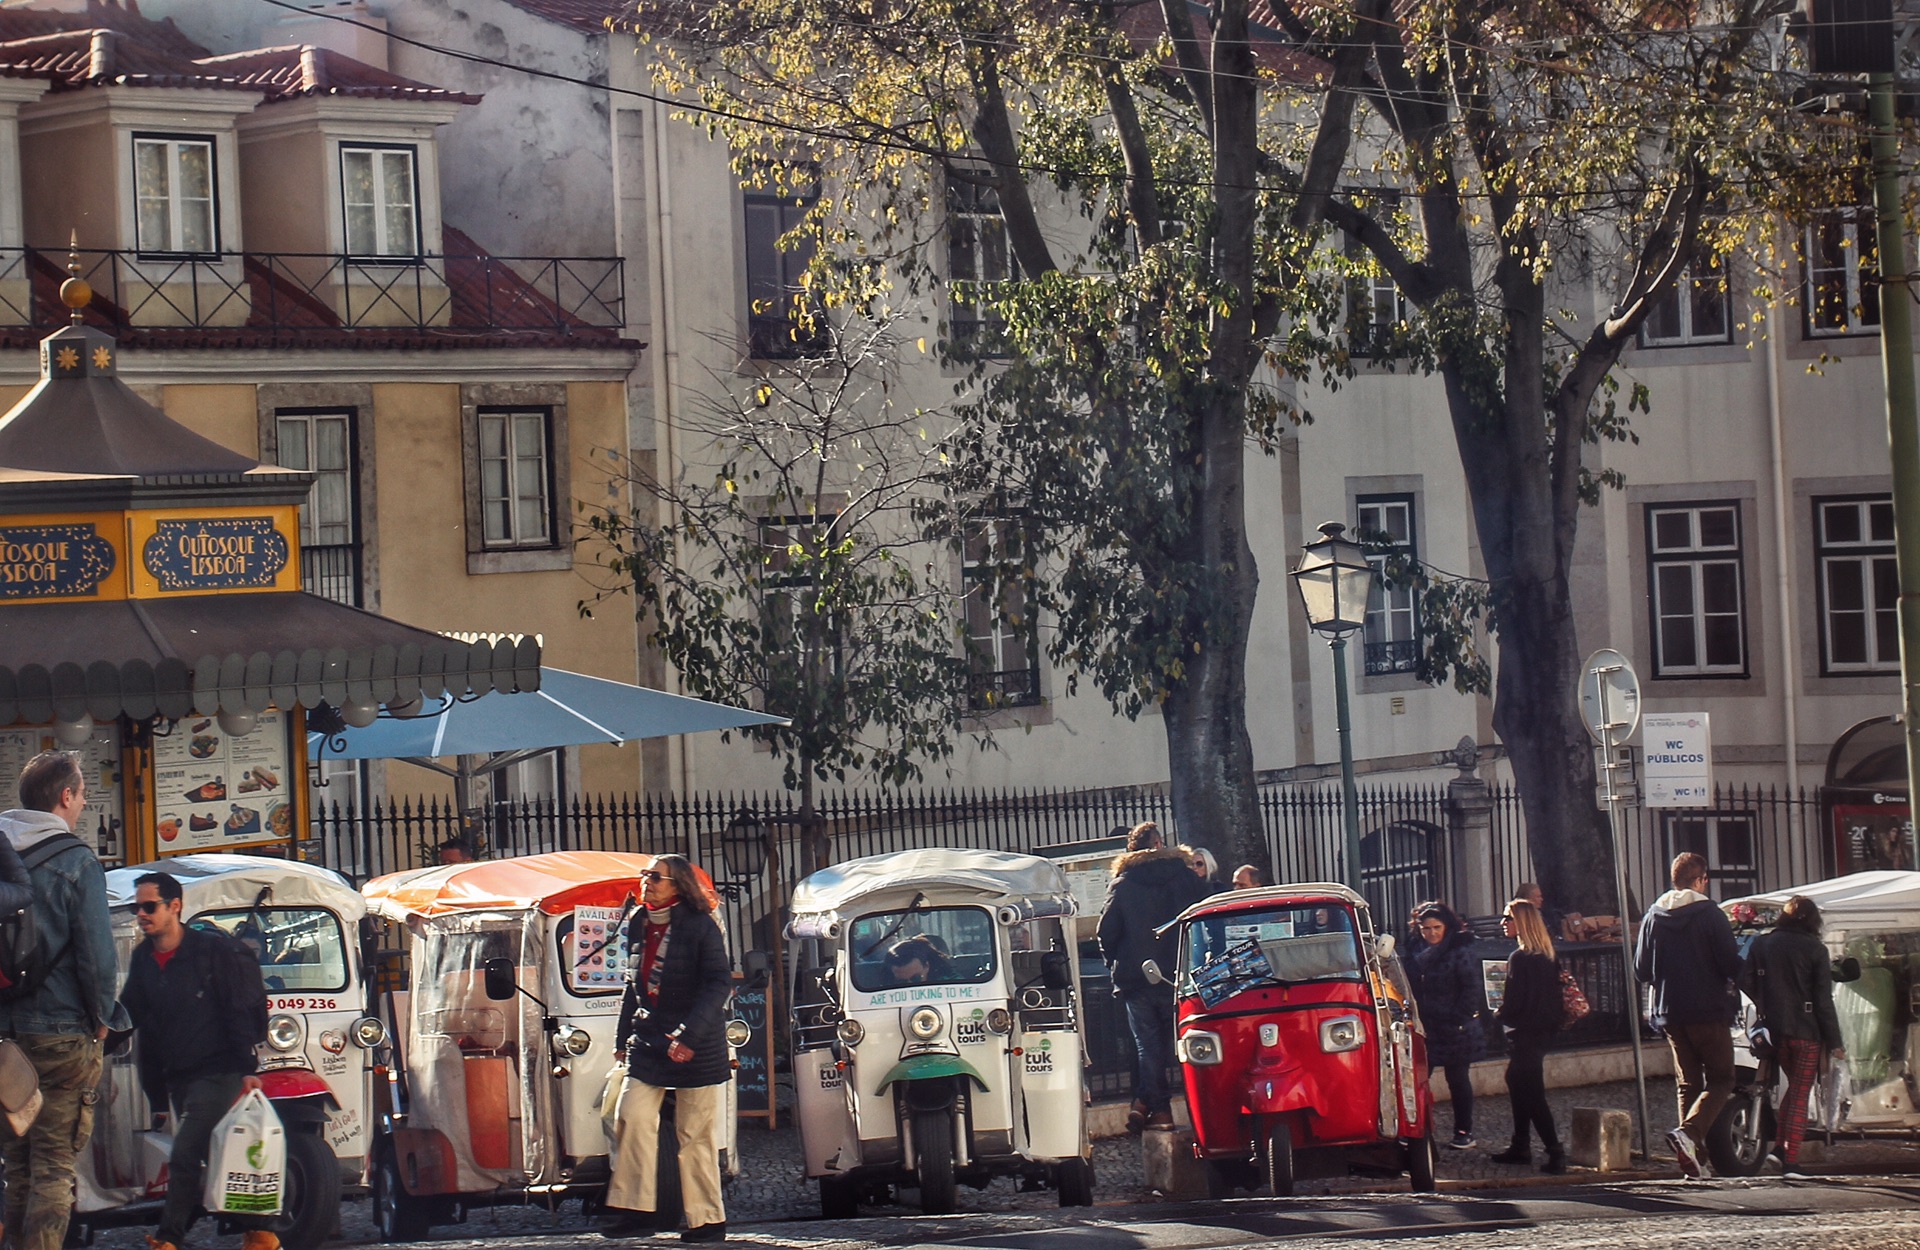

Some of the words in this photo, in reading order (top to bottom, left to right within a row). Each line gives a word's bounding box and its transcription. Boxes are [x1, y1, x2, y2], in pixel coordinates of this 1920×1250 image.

[179, 534, 255, 558] QUIOSQUE
[191, 556, 246, 576] LISBOA
[1665, 740, 1683, 749] WC
[1647, 753, 1704, 763] PÚBLICOS
[1675, 788, 1690, 796] WC
[579, 910, 631, 920] AVAILAB
[1232, 941, 1254, 955] TOUR
[869, 993, 886, 1005] ARE
[890, 991, 907, 1003] YOU
[910, 987, 942, 1001] TUKING
[945, 988, 957, 999] TO
[960, 987, 973, 998] ME
[277, 999, 305, 1009] 049
[308, 999, 336, 1009] 236
[957, 1021, 985, 1035] tuk
[958, 1034, 986, 1043] tours
[1025, 1051, 1052, 1064] tuk
[1026, 1064, 1053, 1072] tours
